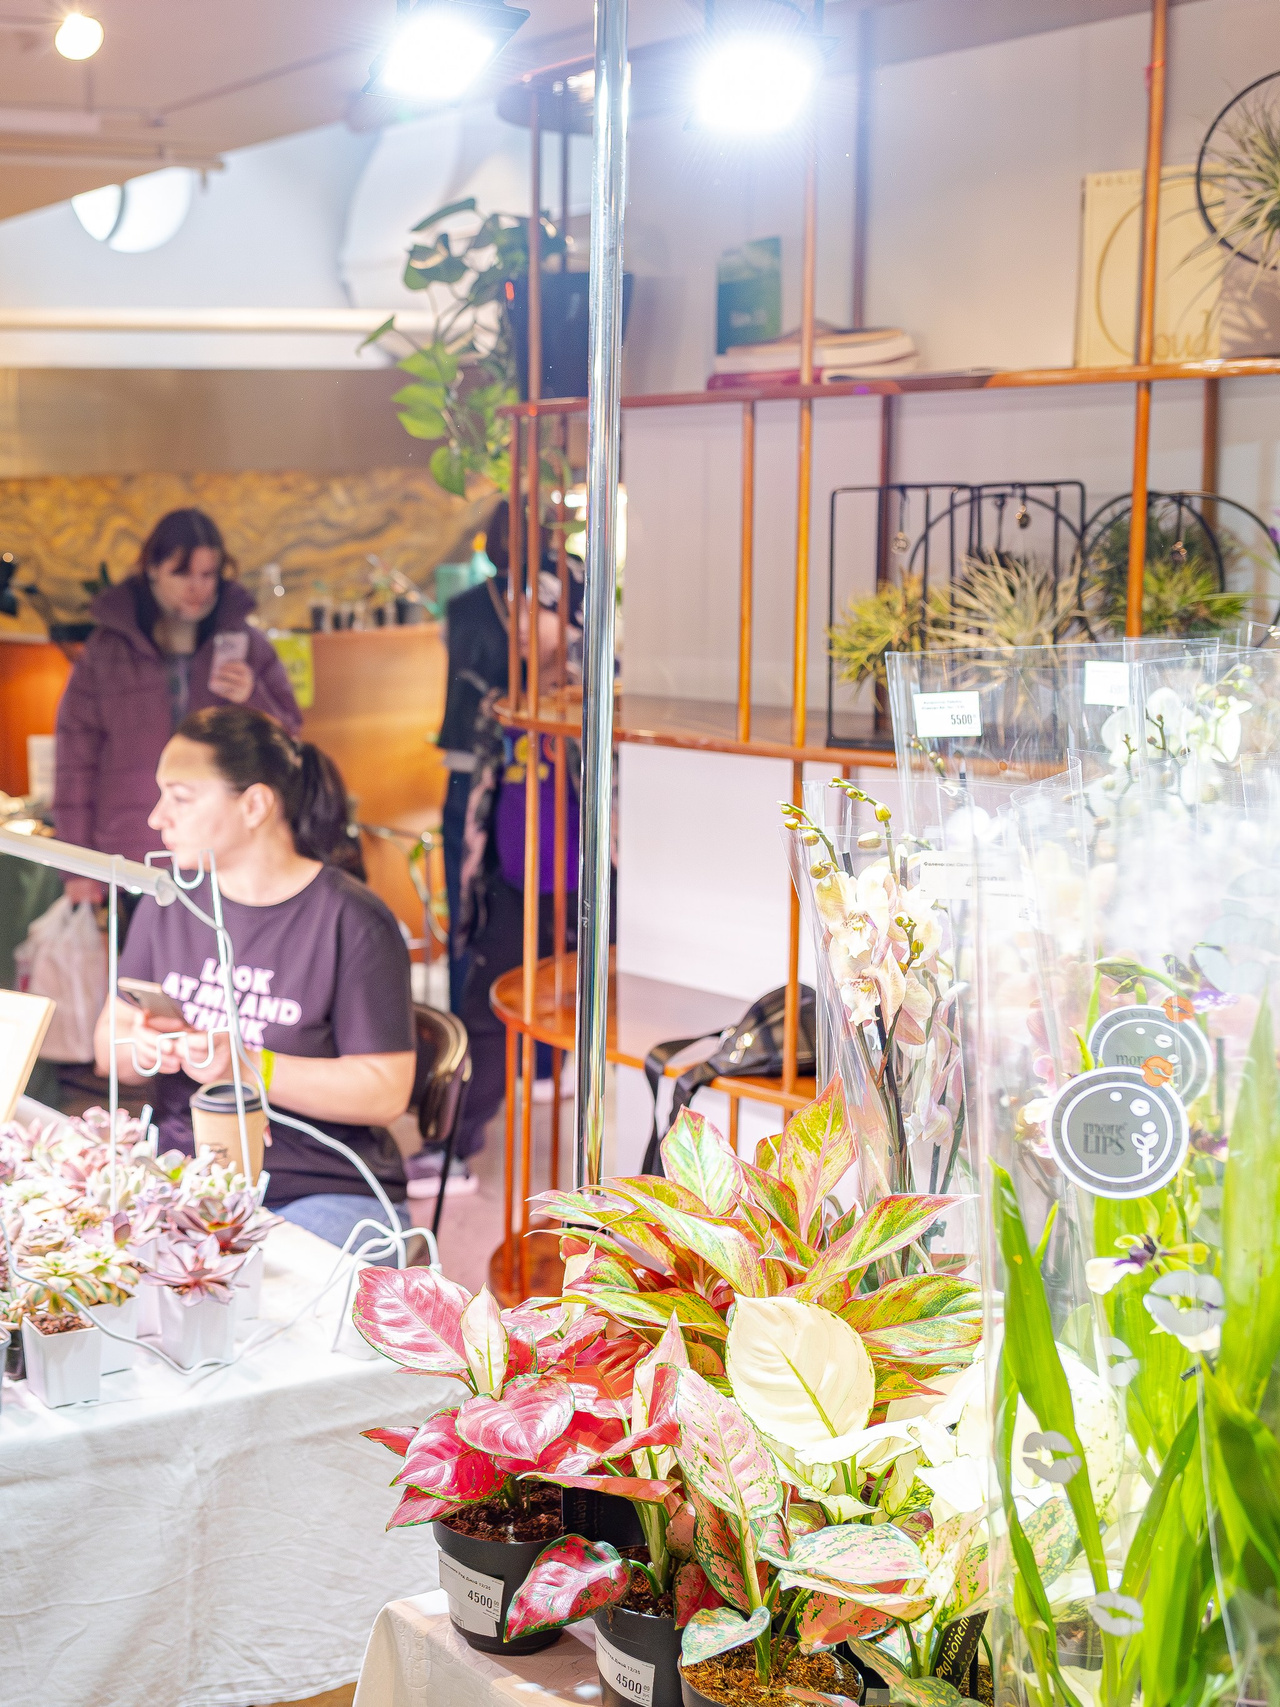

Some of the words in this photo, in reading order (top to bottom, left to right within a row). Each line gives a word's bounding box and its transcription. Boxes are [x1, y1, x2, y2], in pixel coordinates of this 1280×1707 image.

[951, 713, 973, 726] 5500
[162, 971, 200, 1002] AT
[238, 992, 302, 1026] AND
[1115, 1053, 1144, 1067] mor
[1083, 1134, 1126, 1155] LIPS
[467, 1589, 493, 1610] 4500
[615, 1673, 642, 1695] 4500
